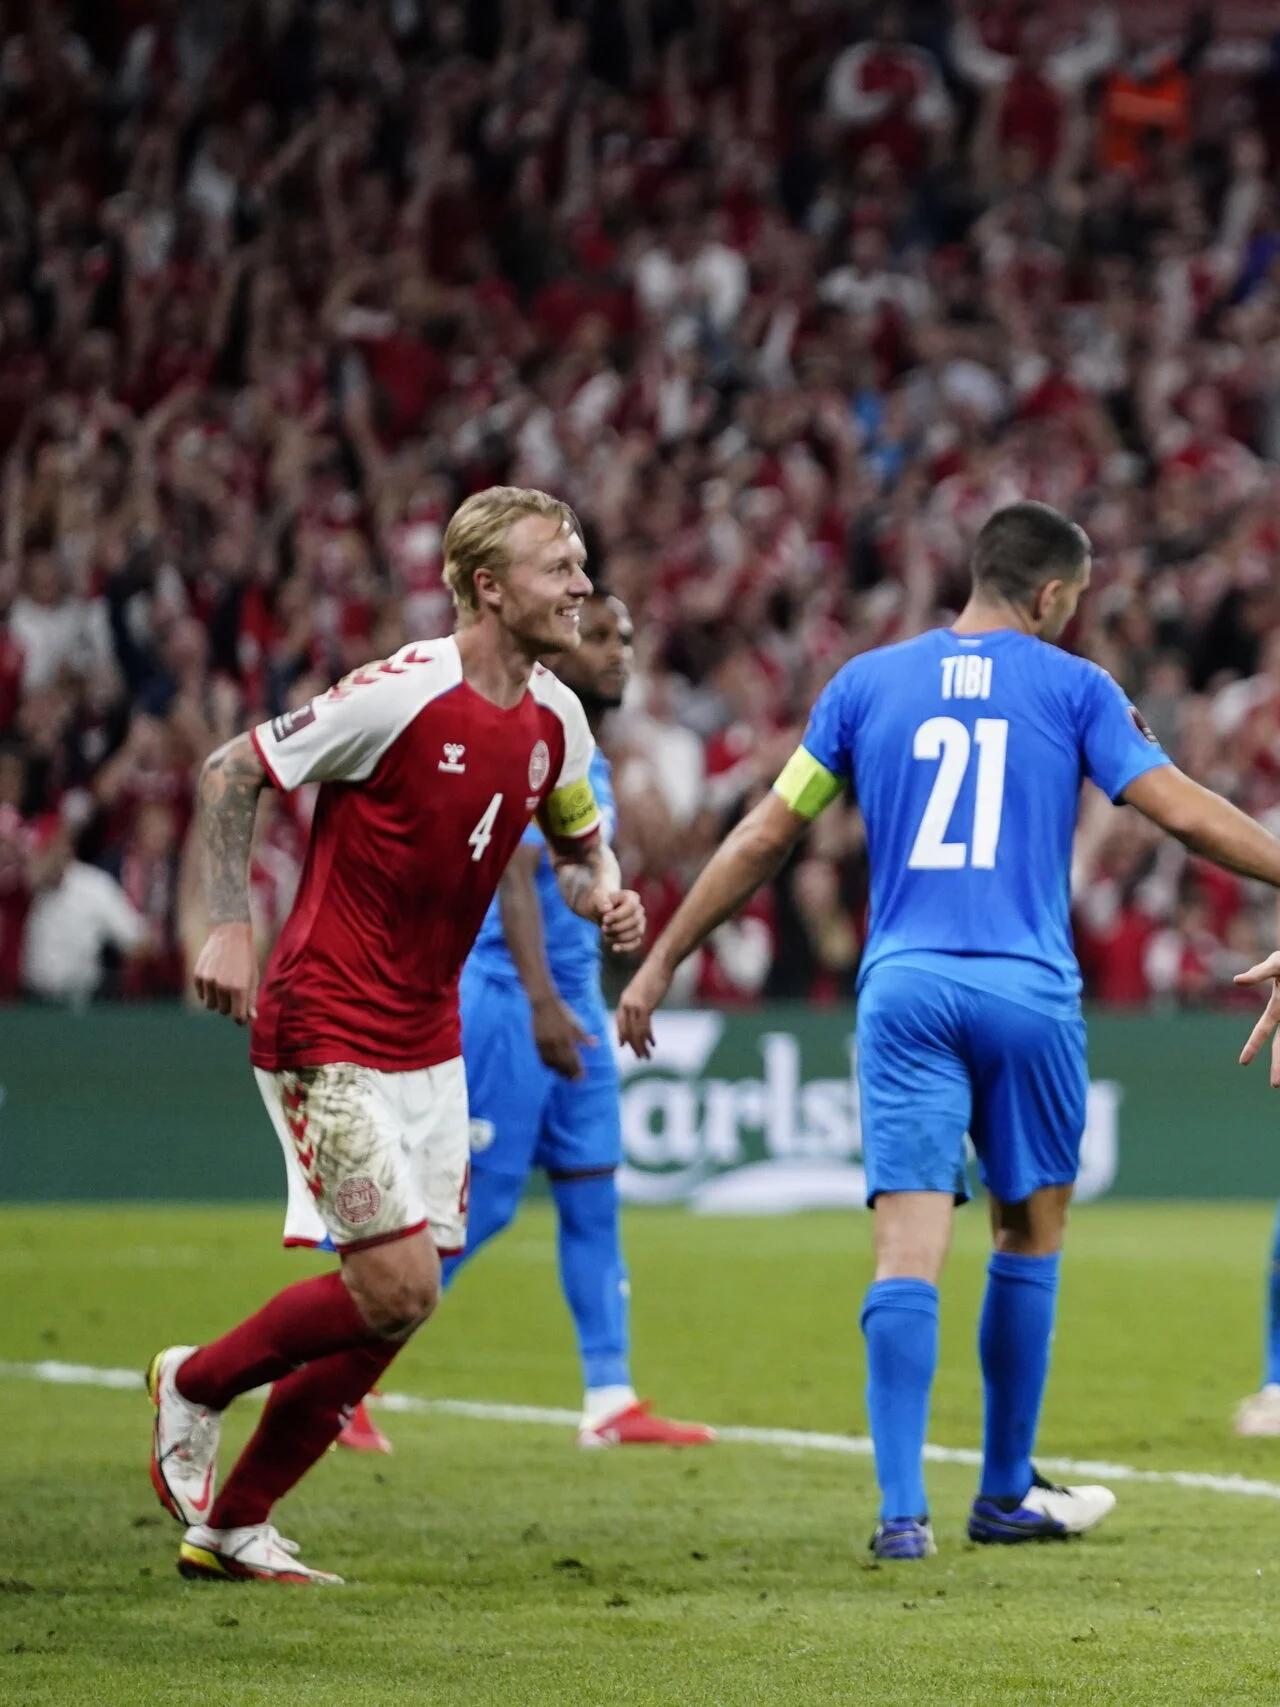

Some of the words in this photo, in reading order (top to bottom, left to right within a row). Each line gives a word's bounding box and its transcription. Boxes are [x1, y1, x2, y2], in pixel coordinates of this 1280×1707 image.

[940, 655, 993, 700] TIBI
[468, 792, 503, 861] 4
[907, 716, 1009, 869] 21
